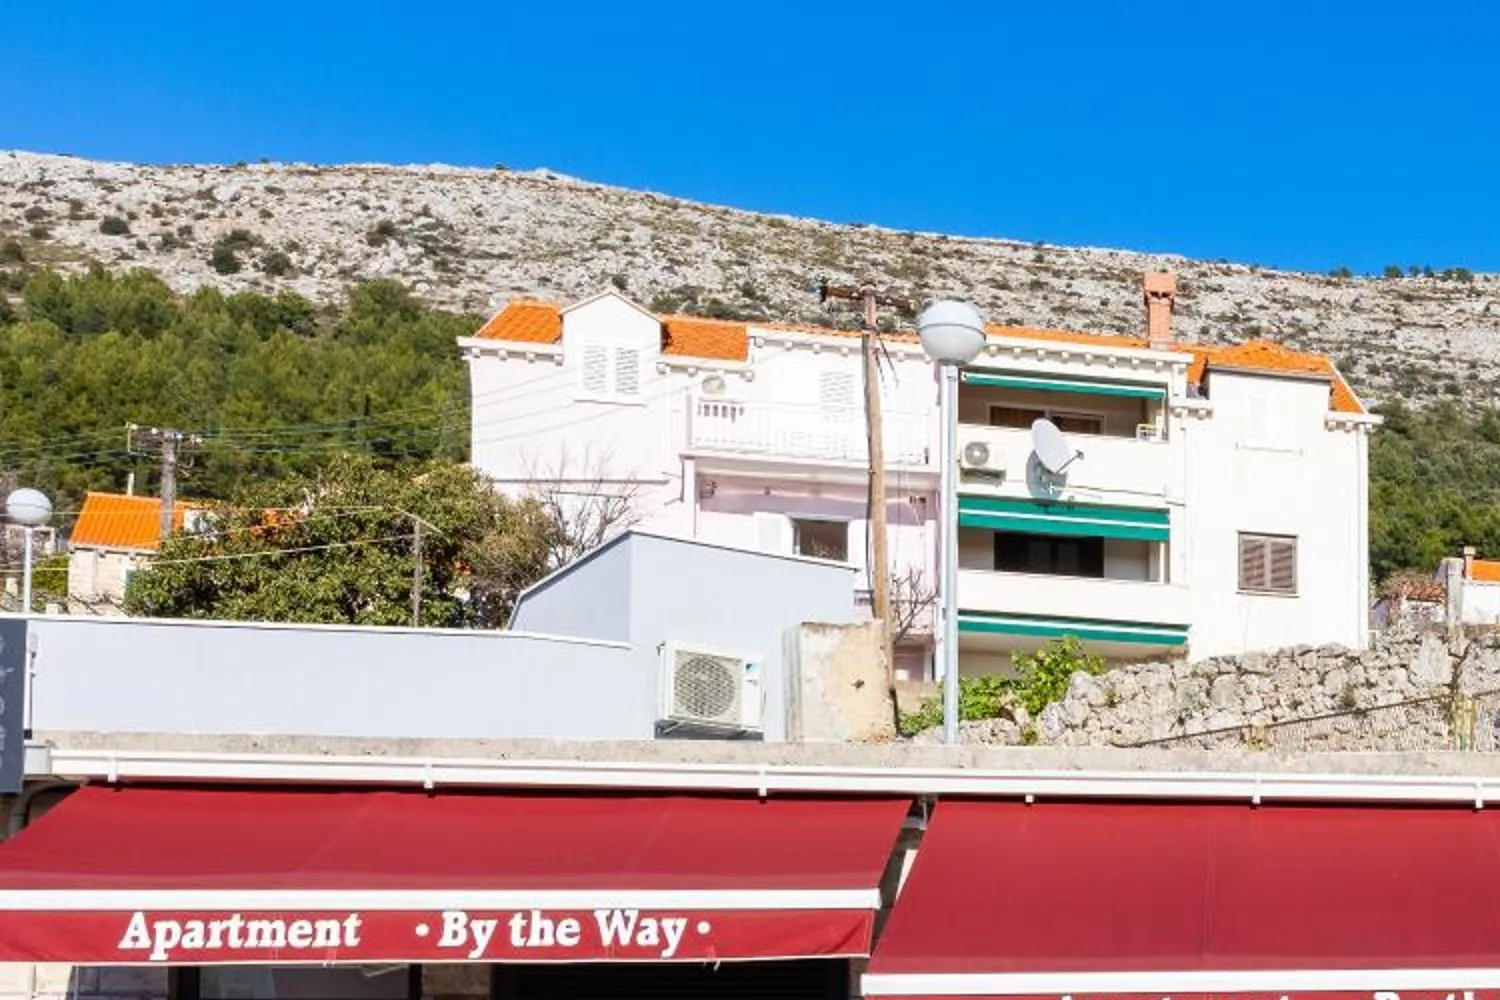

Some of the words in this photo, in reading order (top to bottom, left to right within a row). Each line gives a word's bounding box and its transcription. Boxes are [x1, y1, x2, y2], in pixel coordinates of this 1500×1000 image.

[118, 912, 362, 960] Apartment
[438, 911, 497, 957] By
[508, 909, 580, 948] the
[594, 908, 688, 957] Way
